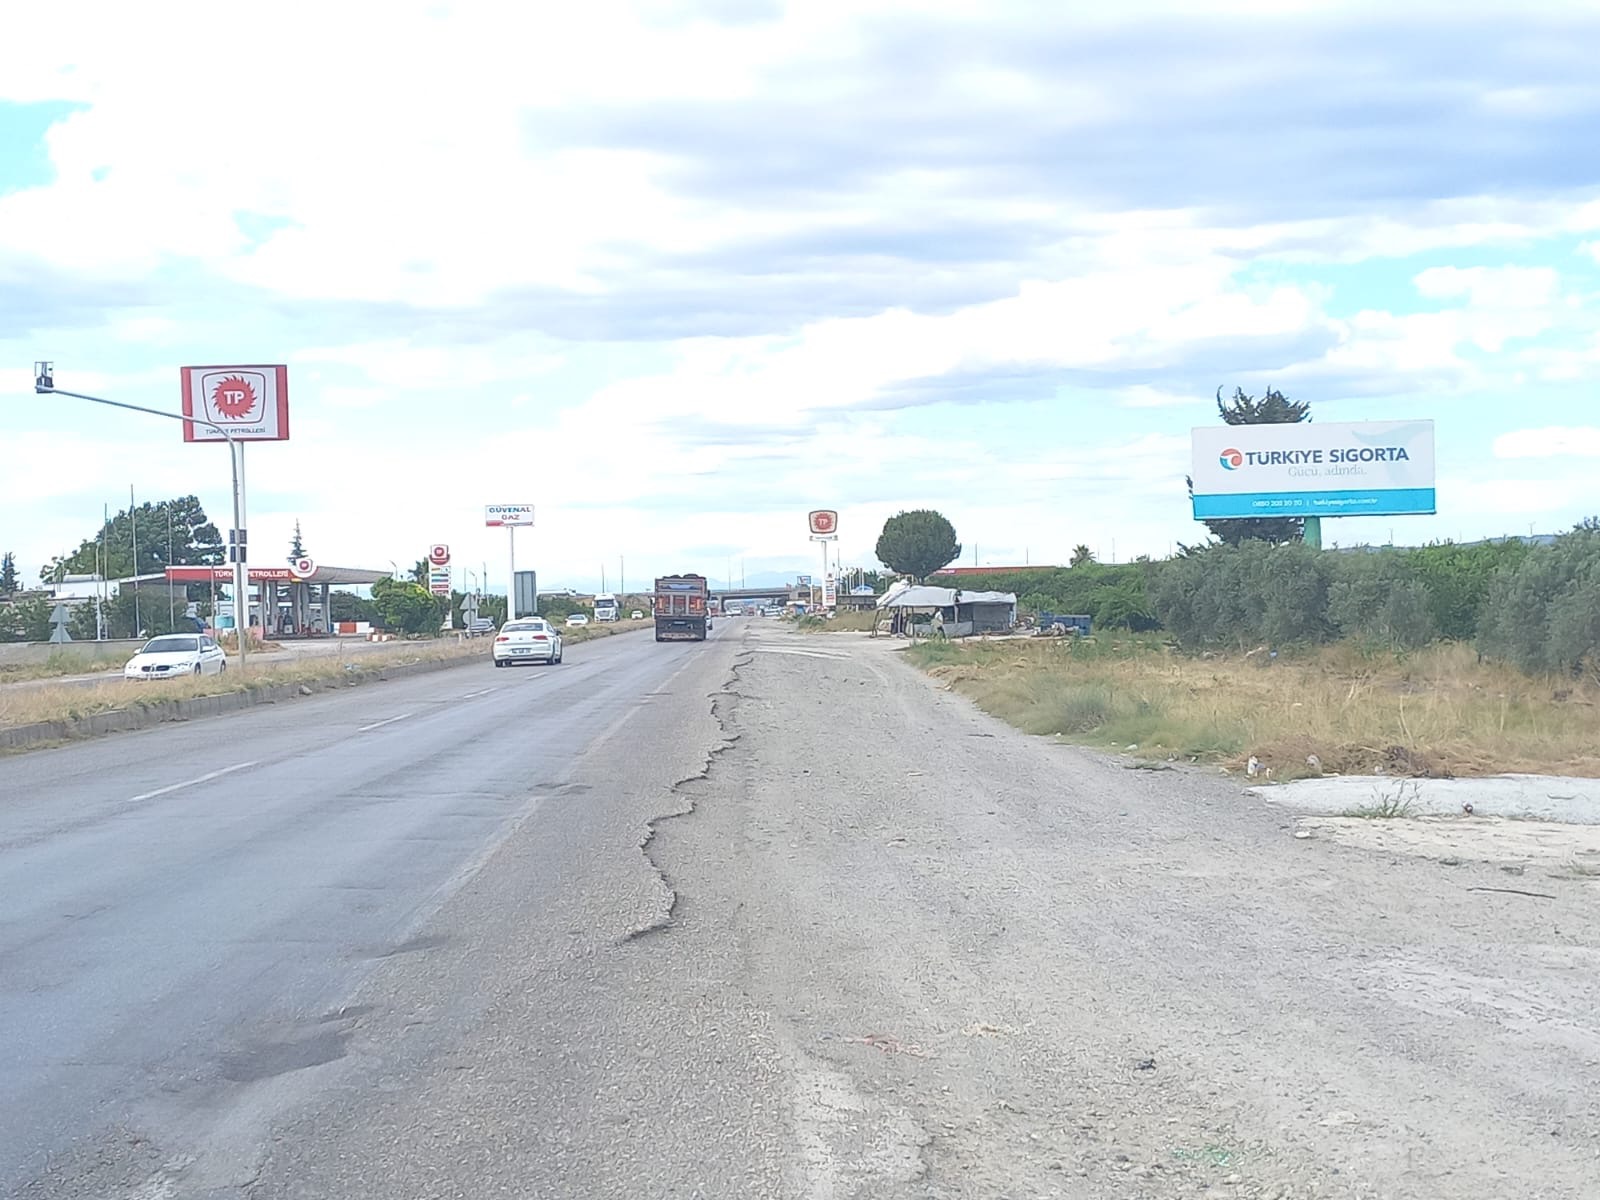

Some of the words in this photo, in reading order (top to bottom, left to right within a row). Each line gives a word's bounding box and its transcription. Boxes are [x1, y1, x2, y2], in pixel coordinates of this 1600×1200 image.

[223, 390, 245, 404] TP
[1245, 449, 1323, 465] TÜRKİYE
[1329, 447, 1409, 463] SİGORTA
